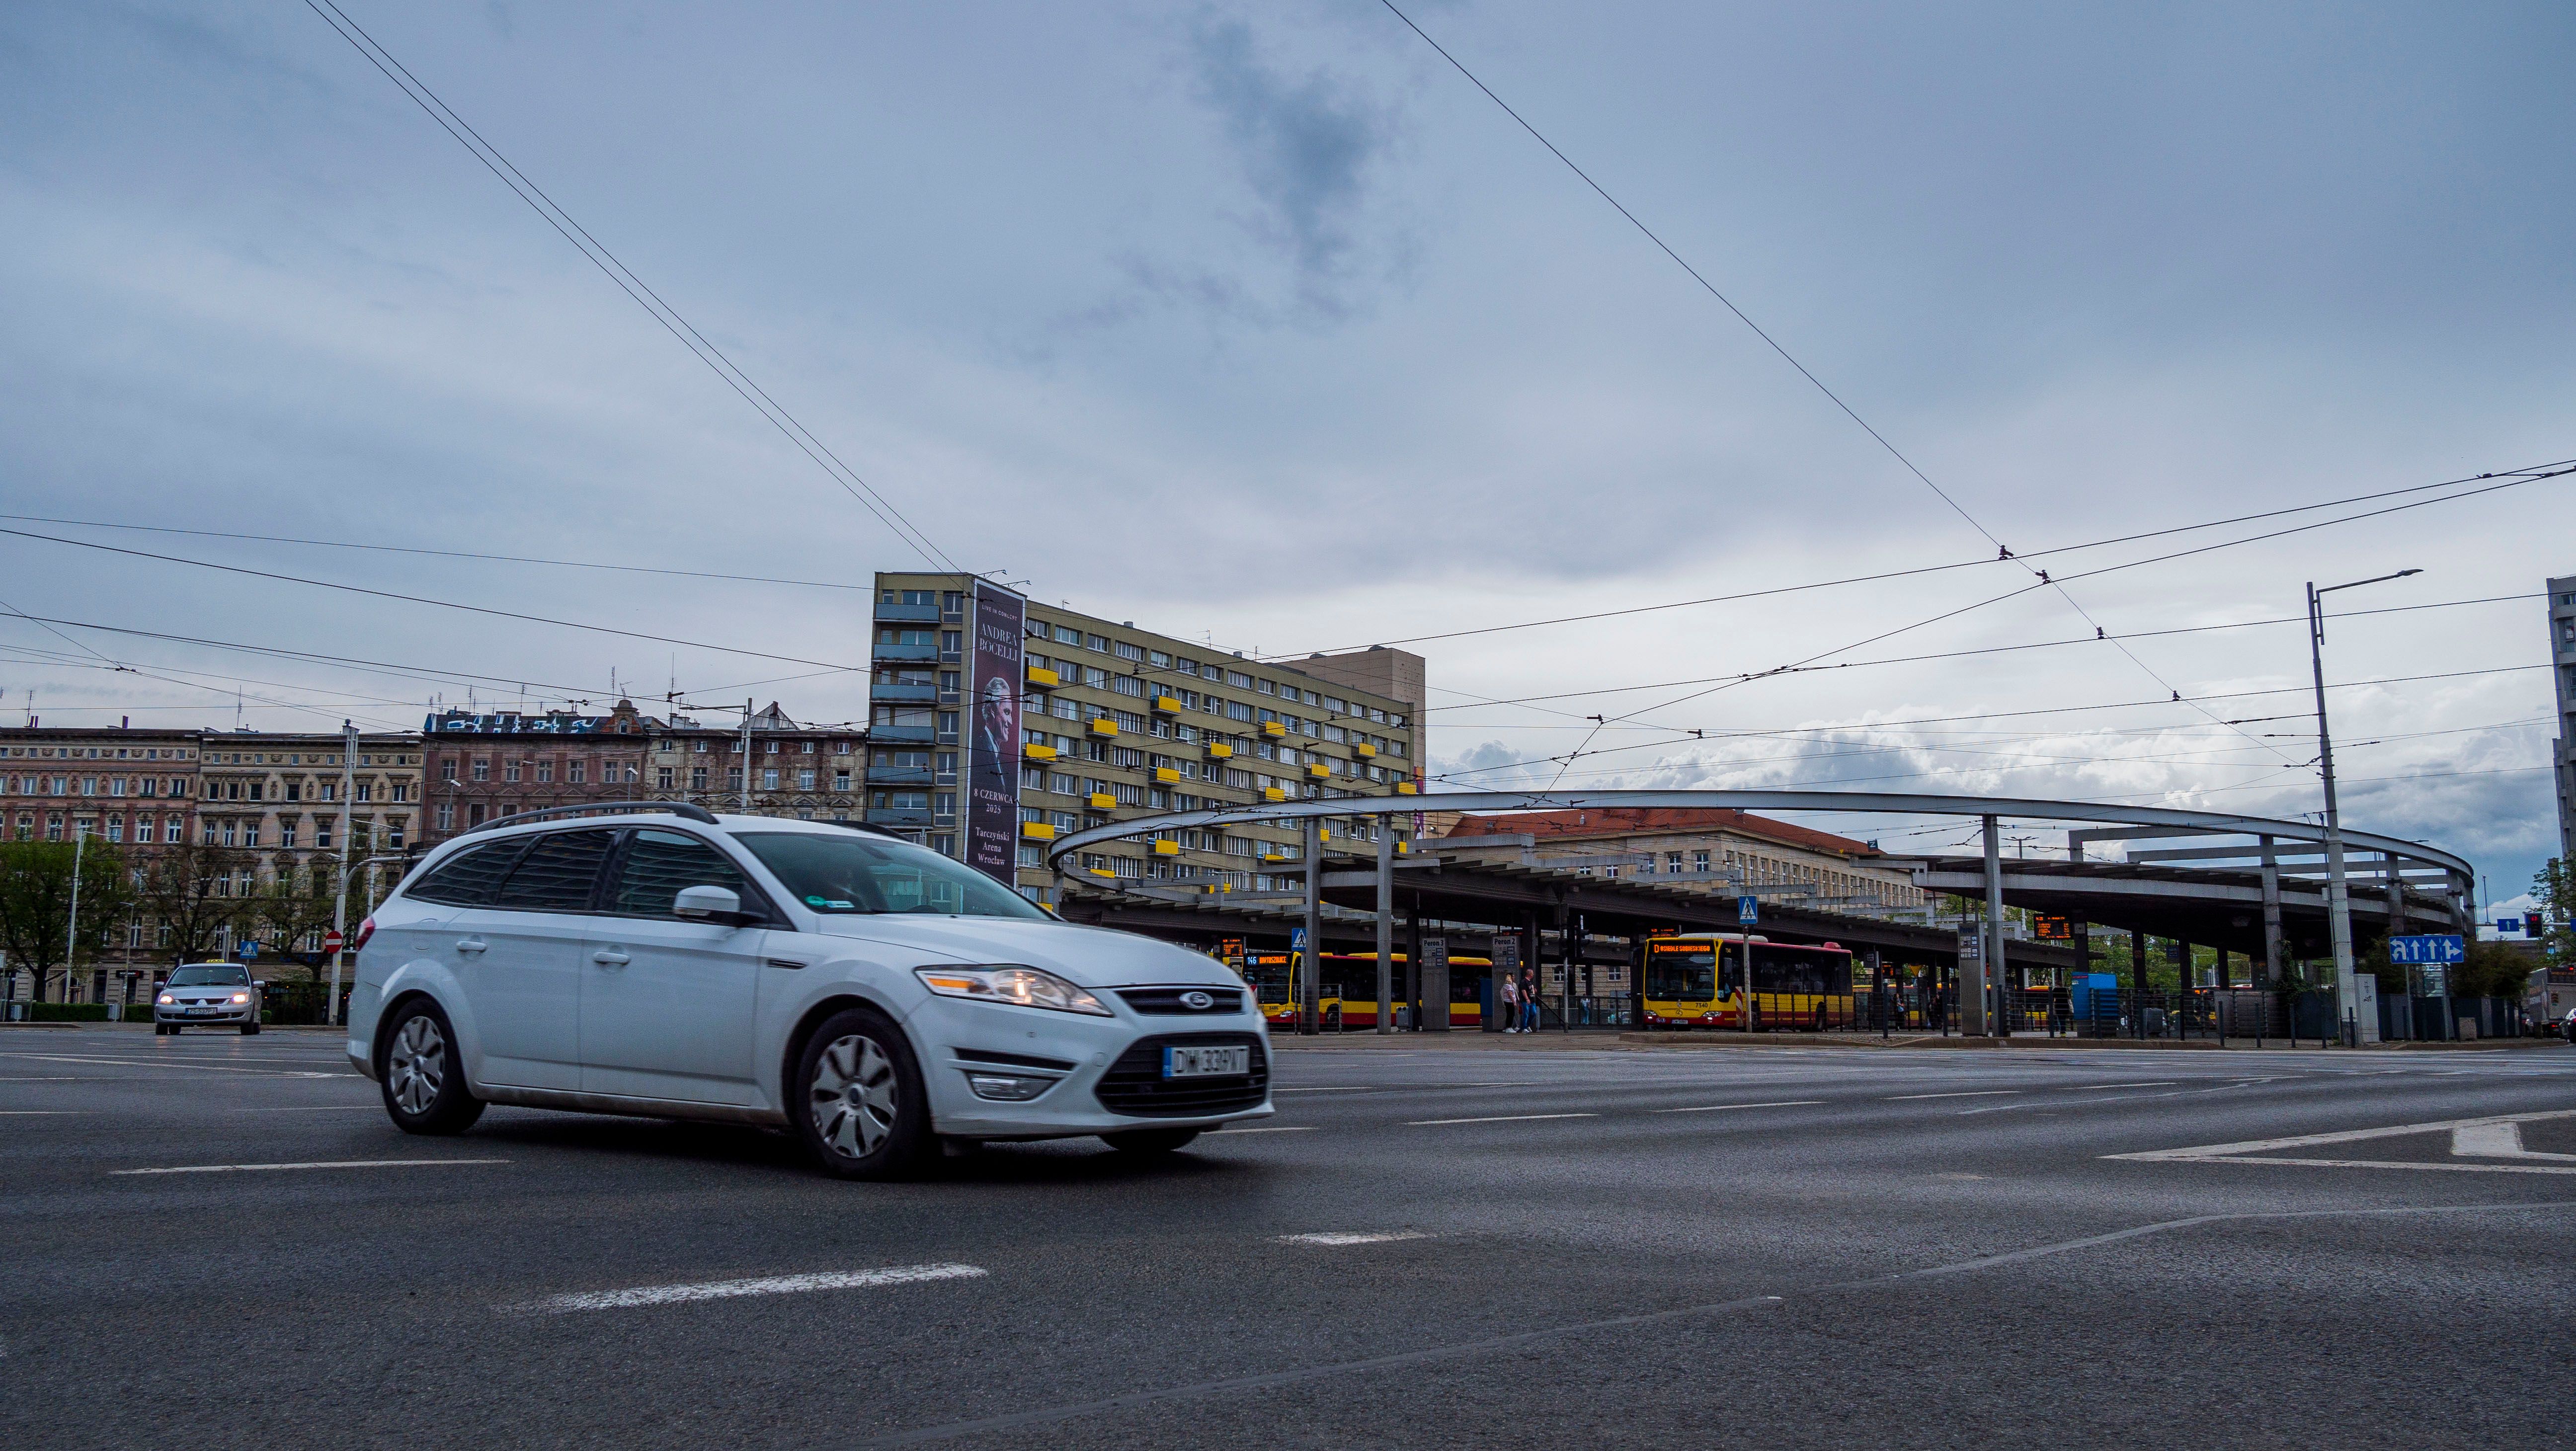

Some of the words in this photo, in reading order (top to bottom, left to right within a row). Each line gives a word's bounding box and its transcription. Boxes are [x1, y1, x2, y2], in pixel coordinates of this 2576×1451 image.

[998, 610, 1017, 621] CONCERT
[980, 623, 1017, 646] ANDREA
[979, 638, 1017, 661] BOCELLI
[974, 788, 978, 797] 8
[980, 789, 1013, 804] CZERWCA
[986, 804, 1001, 814] 2025
[975, 827, 1009, 841] Tarczyński
[982, 842, 1002, 852] Arena
[978, 853, 1005, 865] Wrocław
